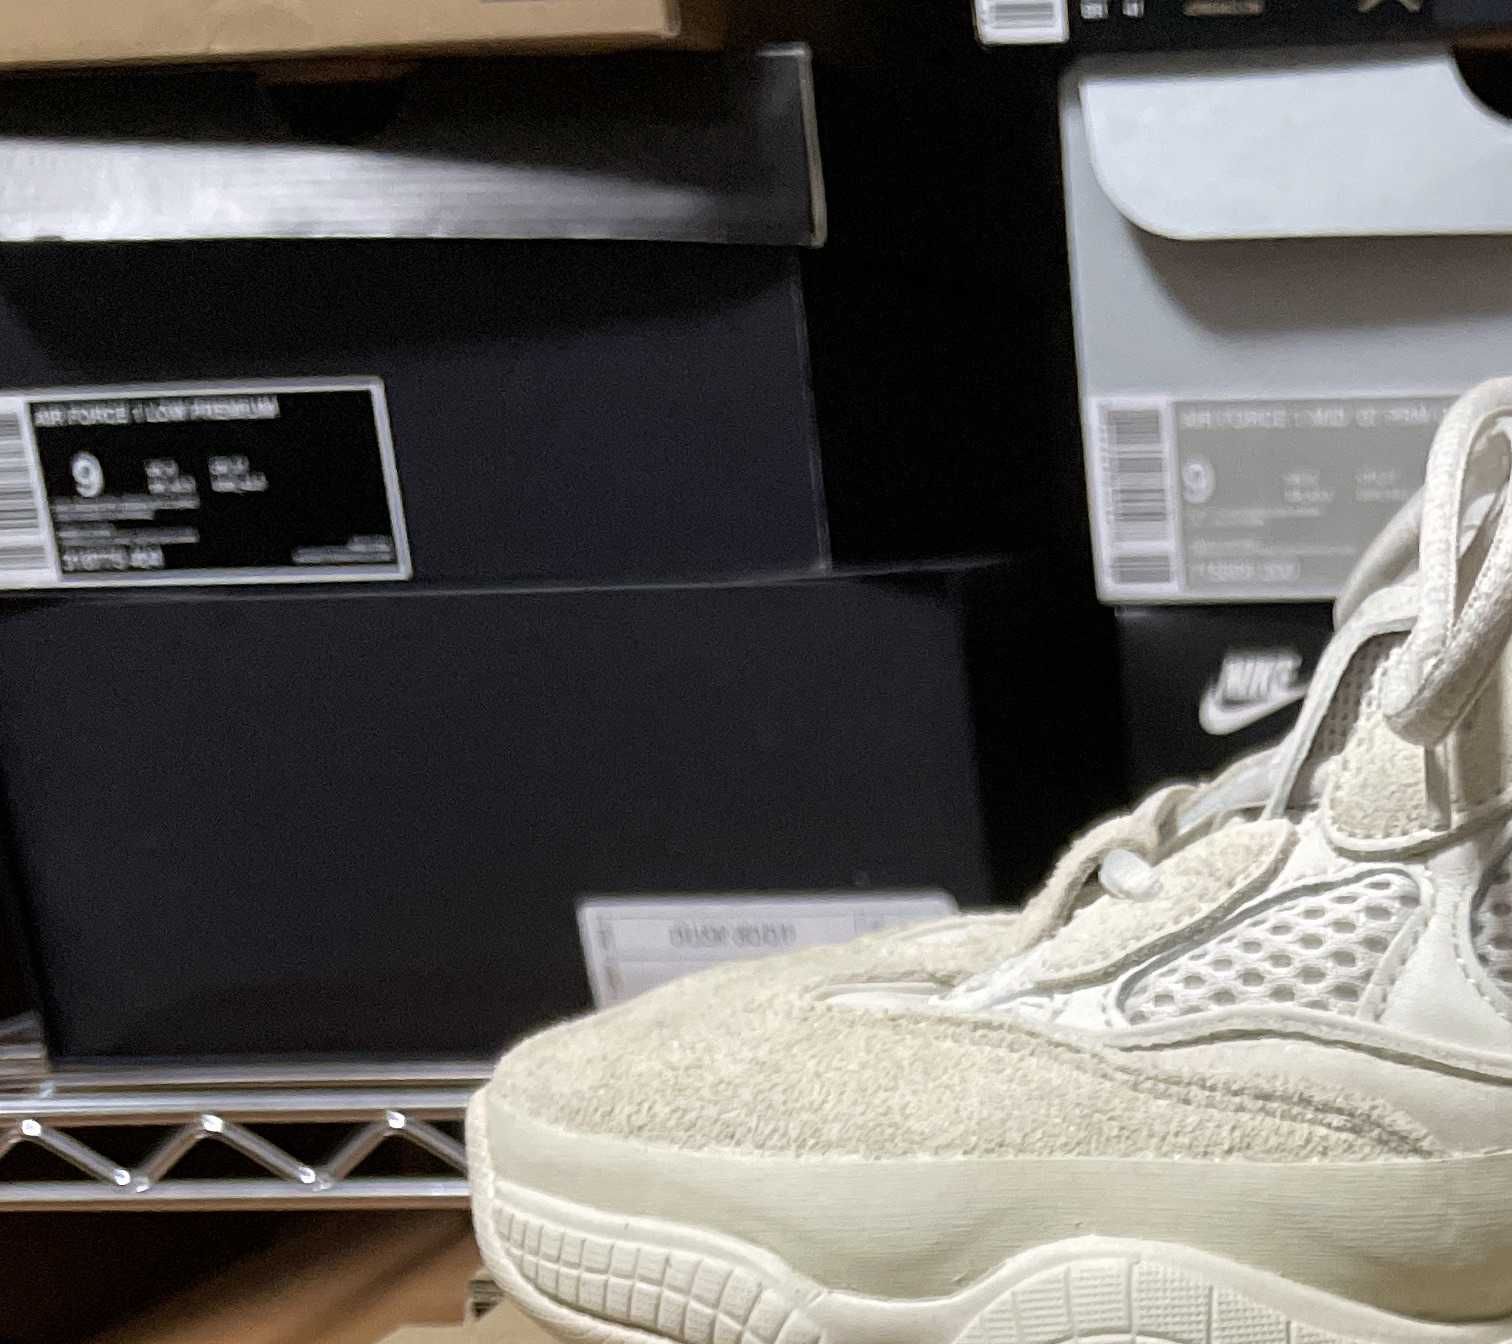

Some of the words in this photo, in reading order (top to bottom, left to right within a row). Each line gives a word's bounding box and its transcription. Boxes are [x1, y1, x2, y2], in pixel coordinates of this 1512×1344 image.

[33, 409, 64, 427] AIR
[67, 405, 127, 425] FORCE
[71, 450, 105, 498] 9
[1183, 455, 1215, 504] 9
[1216, 653, 1303, 704] NIKE
